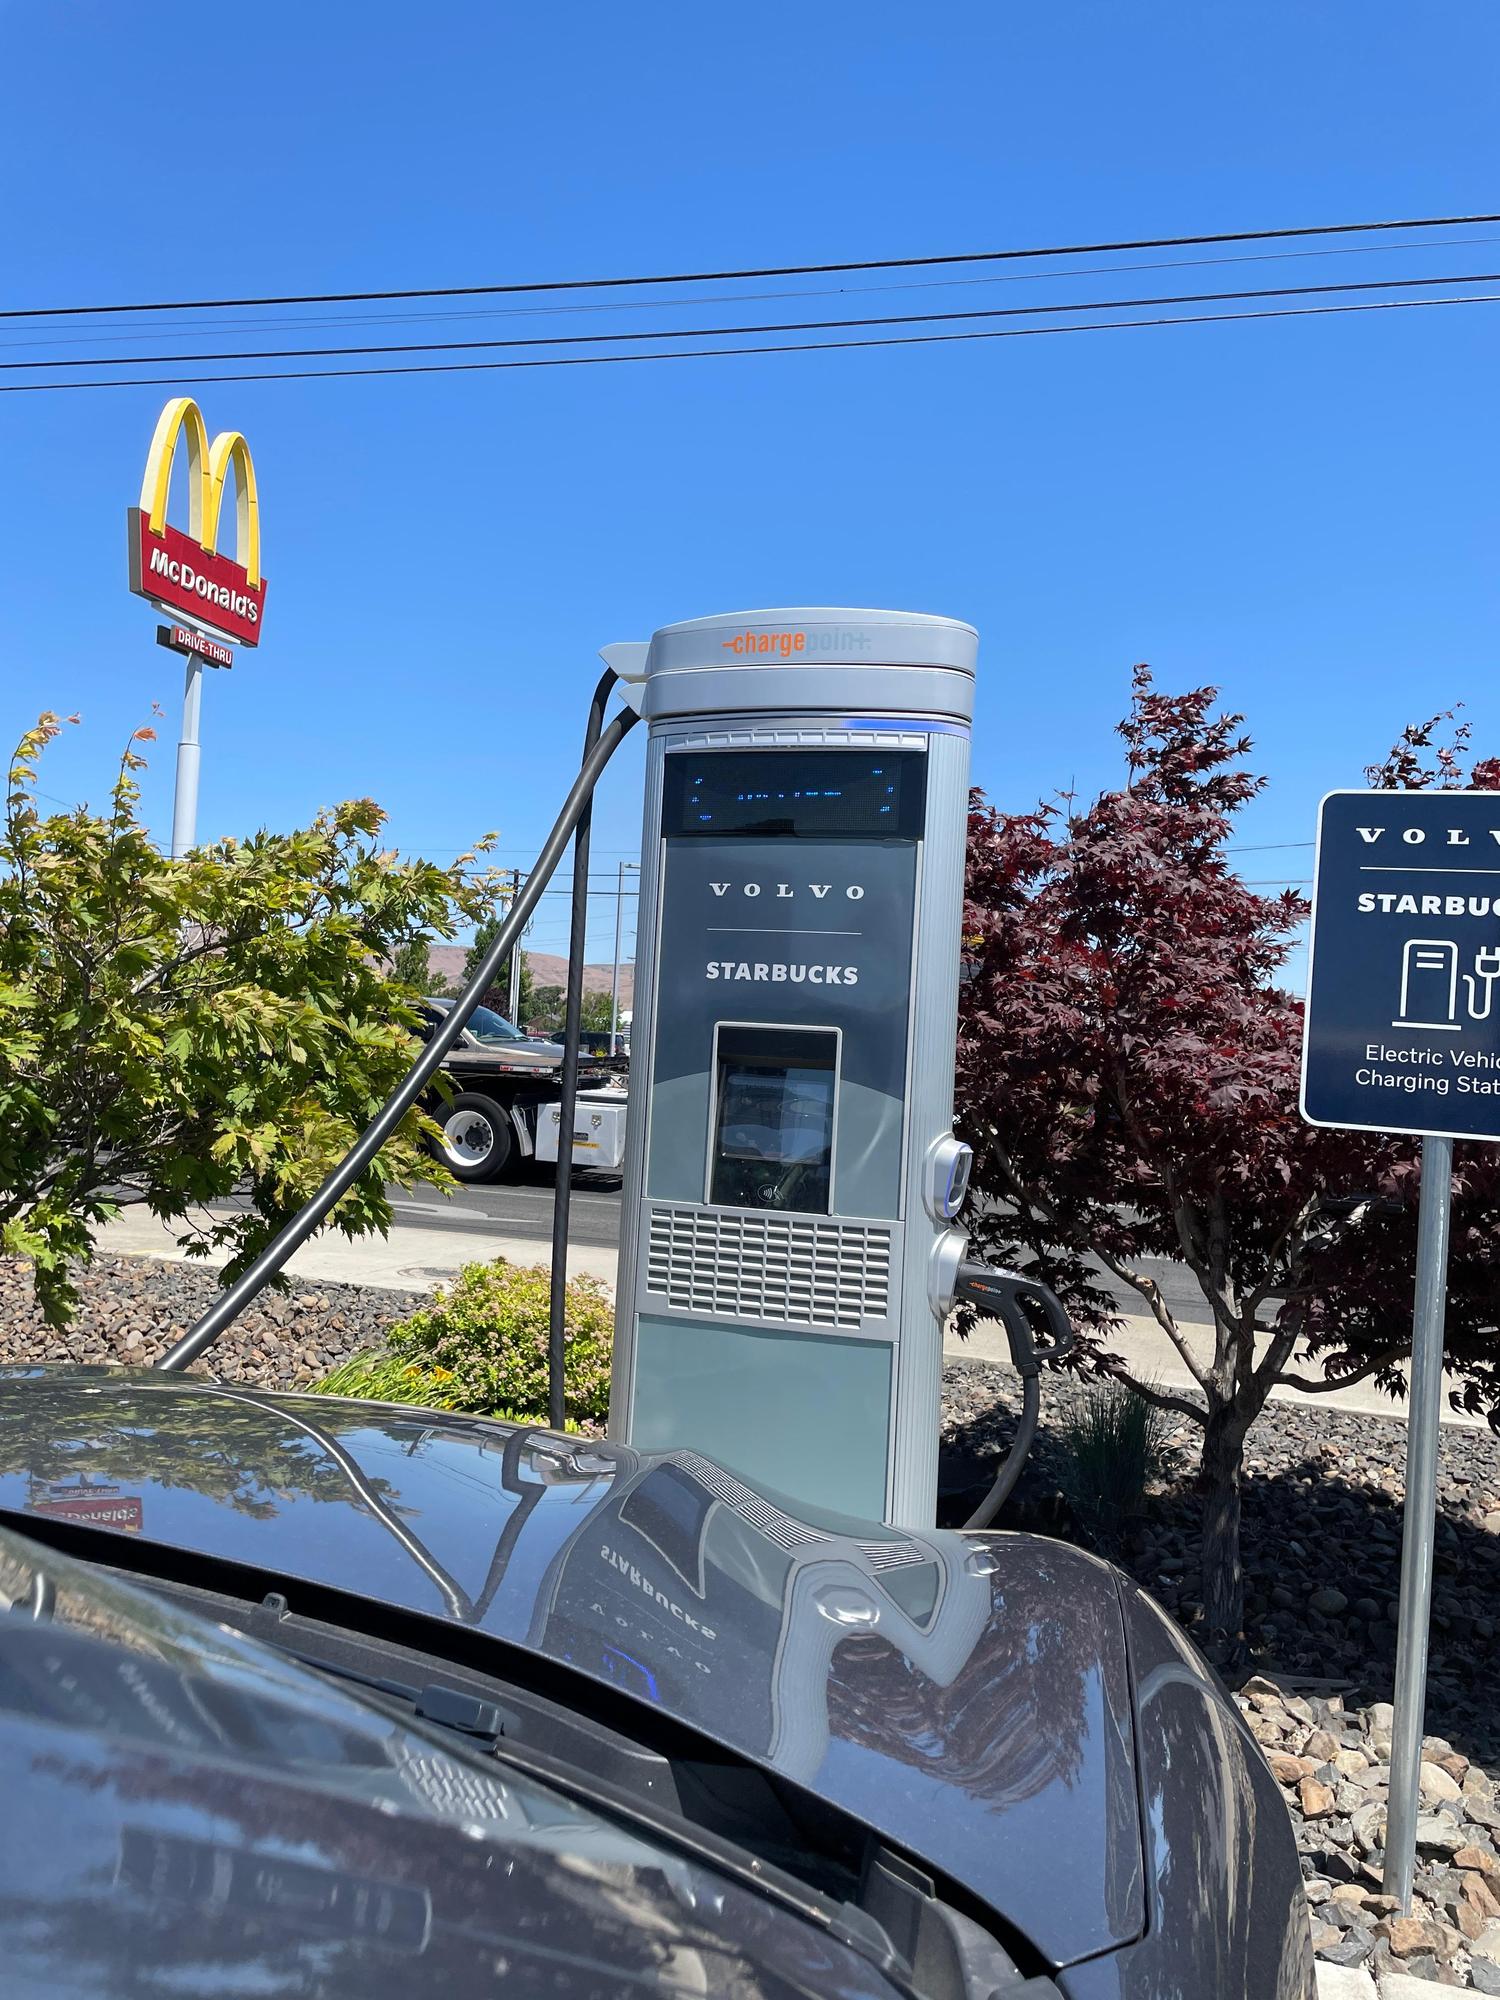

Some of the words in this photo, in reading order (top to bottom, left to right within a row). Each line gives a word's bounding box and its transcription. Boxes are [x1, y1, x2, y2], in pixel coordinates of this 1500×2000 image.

[150, 547, 258, 623] McDonald's
[178, 629, 232, 664] DRIVE-THRU
[708, 882, 866, 900] VOLVO
[706, 961, 859, 986] STARBUCKS
[1366, 1044, 1444, 1066] Electric
[1355, 1068, 1449, 1095] Charging
